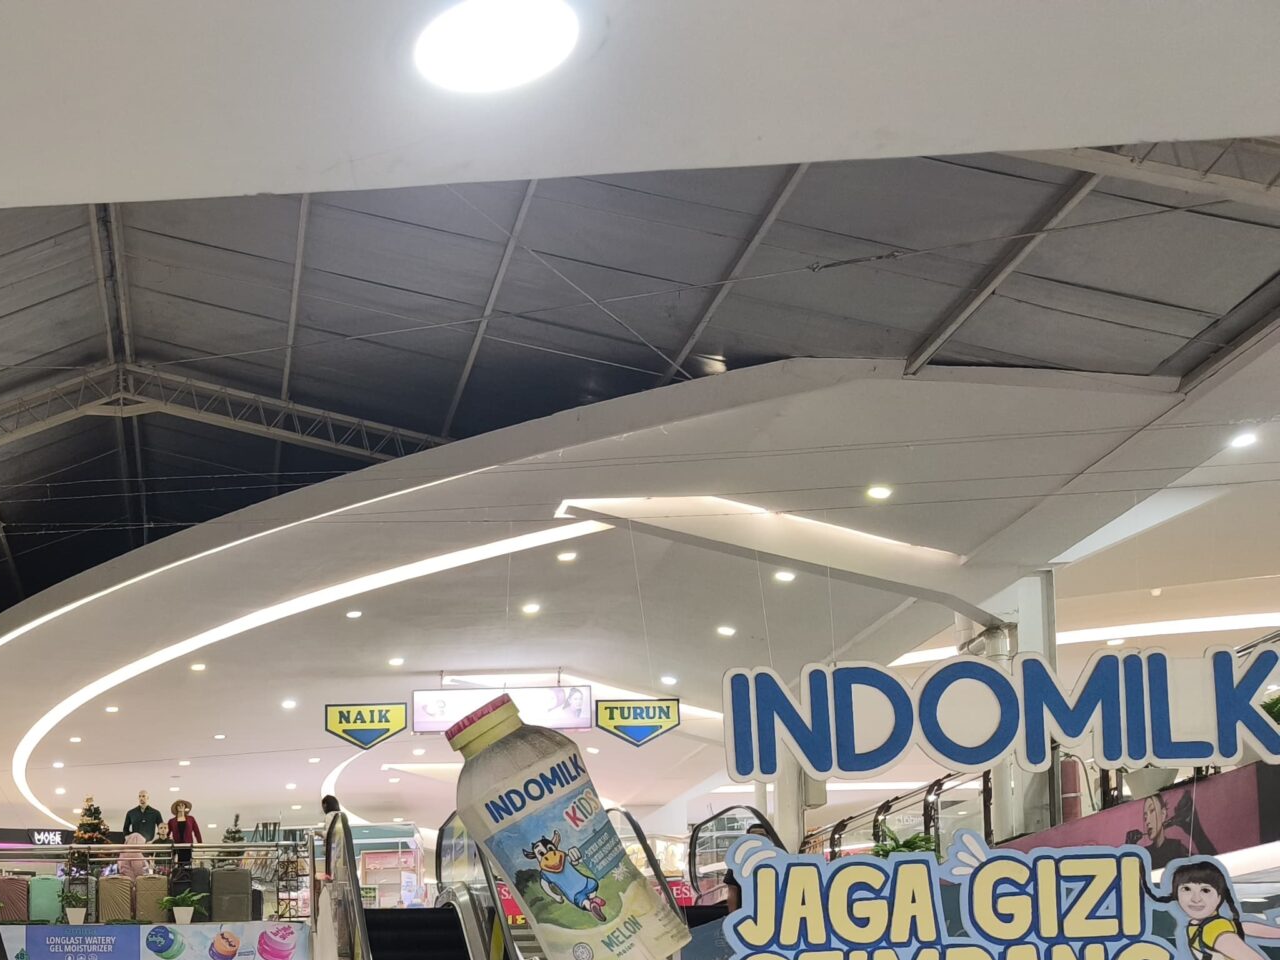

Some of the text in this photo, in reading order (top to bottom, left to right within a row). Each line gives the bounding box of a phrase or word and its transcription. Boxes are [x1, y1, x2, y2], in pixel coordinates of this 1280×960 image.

[338, 708, 392, 725] NAIK
[604, 705, 672, 721] TURUN
[729, 650, 1280, 776] INDOMILK
[484, 753, 587, 824] INDOMILK
[736, 859, 939, 946] JAGA
[970, 856, 1143, 942] GIZI
[46, 936, 117, 945] LONGLAST WATERY
[49, 944, 113, 953] GEL MOISTURIZER
[600, 914, 643, 953] MELON
